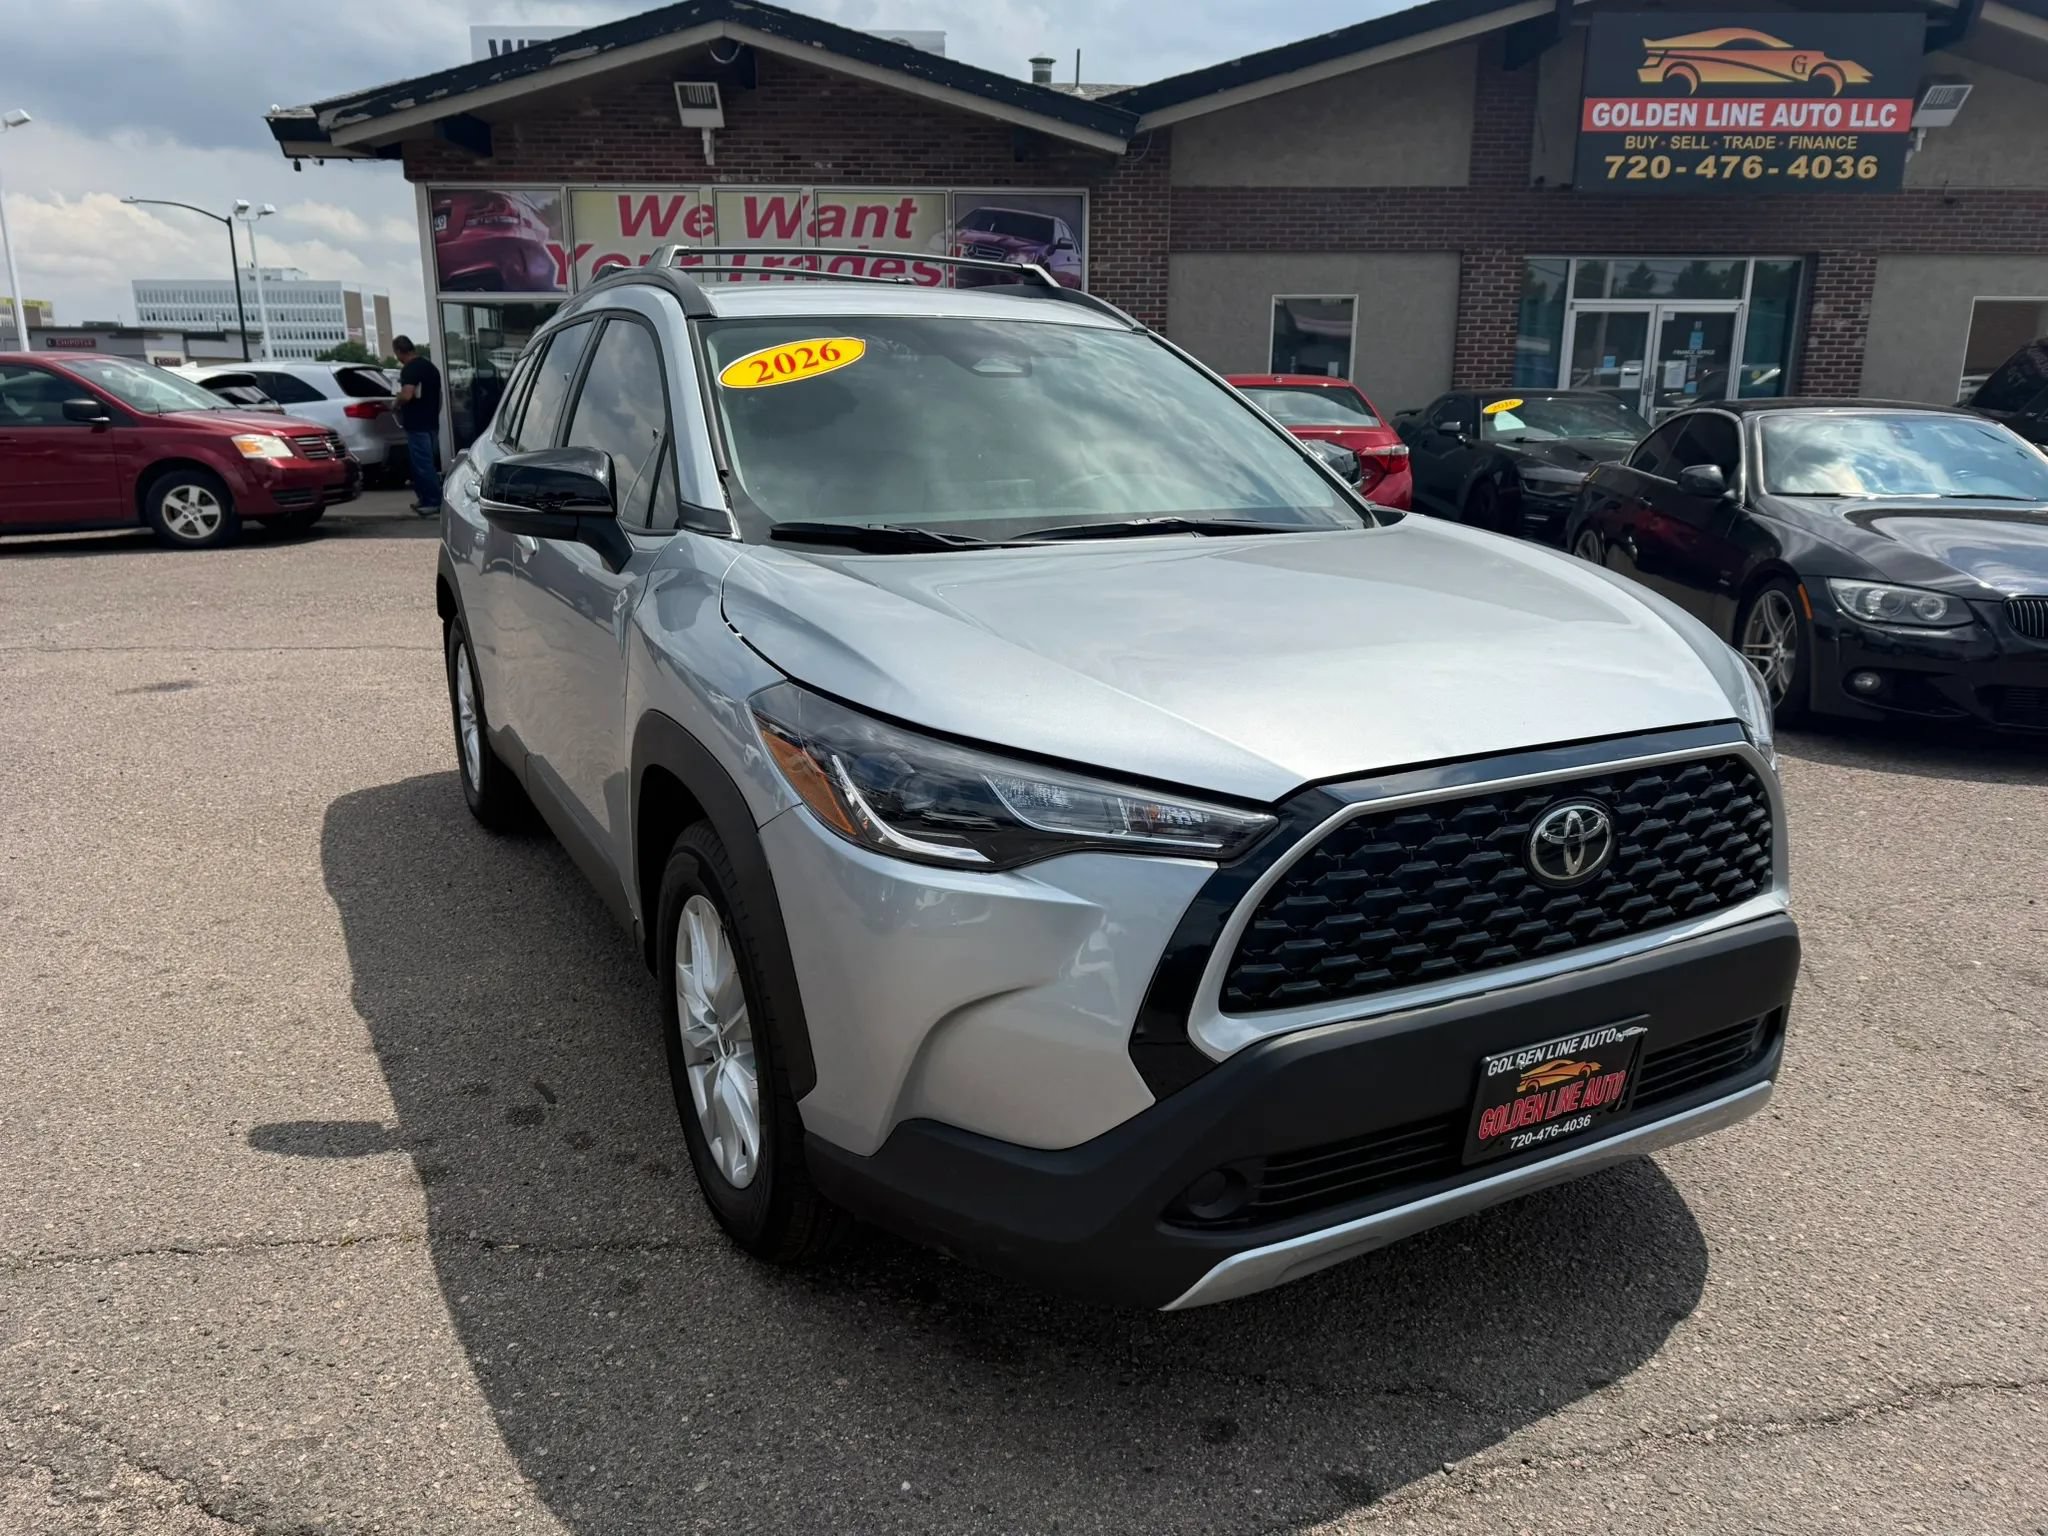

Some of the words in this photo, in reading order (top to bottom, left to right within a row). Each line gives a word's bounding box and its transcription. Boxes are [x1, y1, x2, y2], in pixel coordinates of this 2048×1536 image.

[1592, 103, 1698, 127] GOLDEN
[1705, 103, 1765, 127] LINE
[1771, 103, 1842, 128] AUTO
[1850, 103, 1897, 128] LLC
[1625, 136, 1658, 149] BUY
[1670, 136, 1710, 149] SELL
[1723, 136, 1777, 149] TRADE
[1788, 136, 1858, 149] FINANCE
[1605, 155, 1878, 179] 720-476-4036
[617, 195, 714, 237] We
[743, 195, 917, 239] Want
[749, 340, 841, 383] 2026
[1487, 1047, 1544, 1077] GOLDEN
[1547, 1038, 1579, 1059] LINE
[1581, 1028, 1617, 1049] AUTO
[1478, 1091, 1548, 1140] GOLDEN
[1545, 1081, 1583, 1120] LINE
[1582, 1070, 1626, 1109] AUTO
[1510, 1114, 1592, 1150] 720-476-4036
